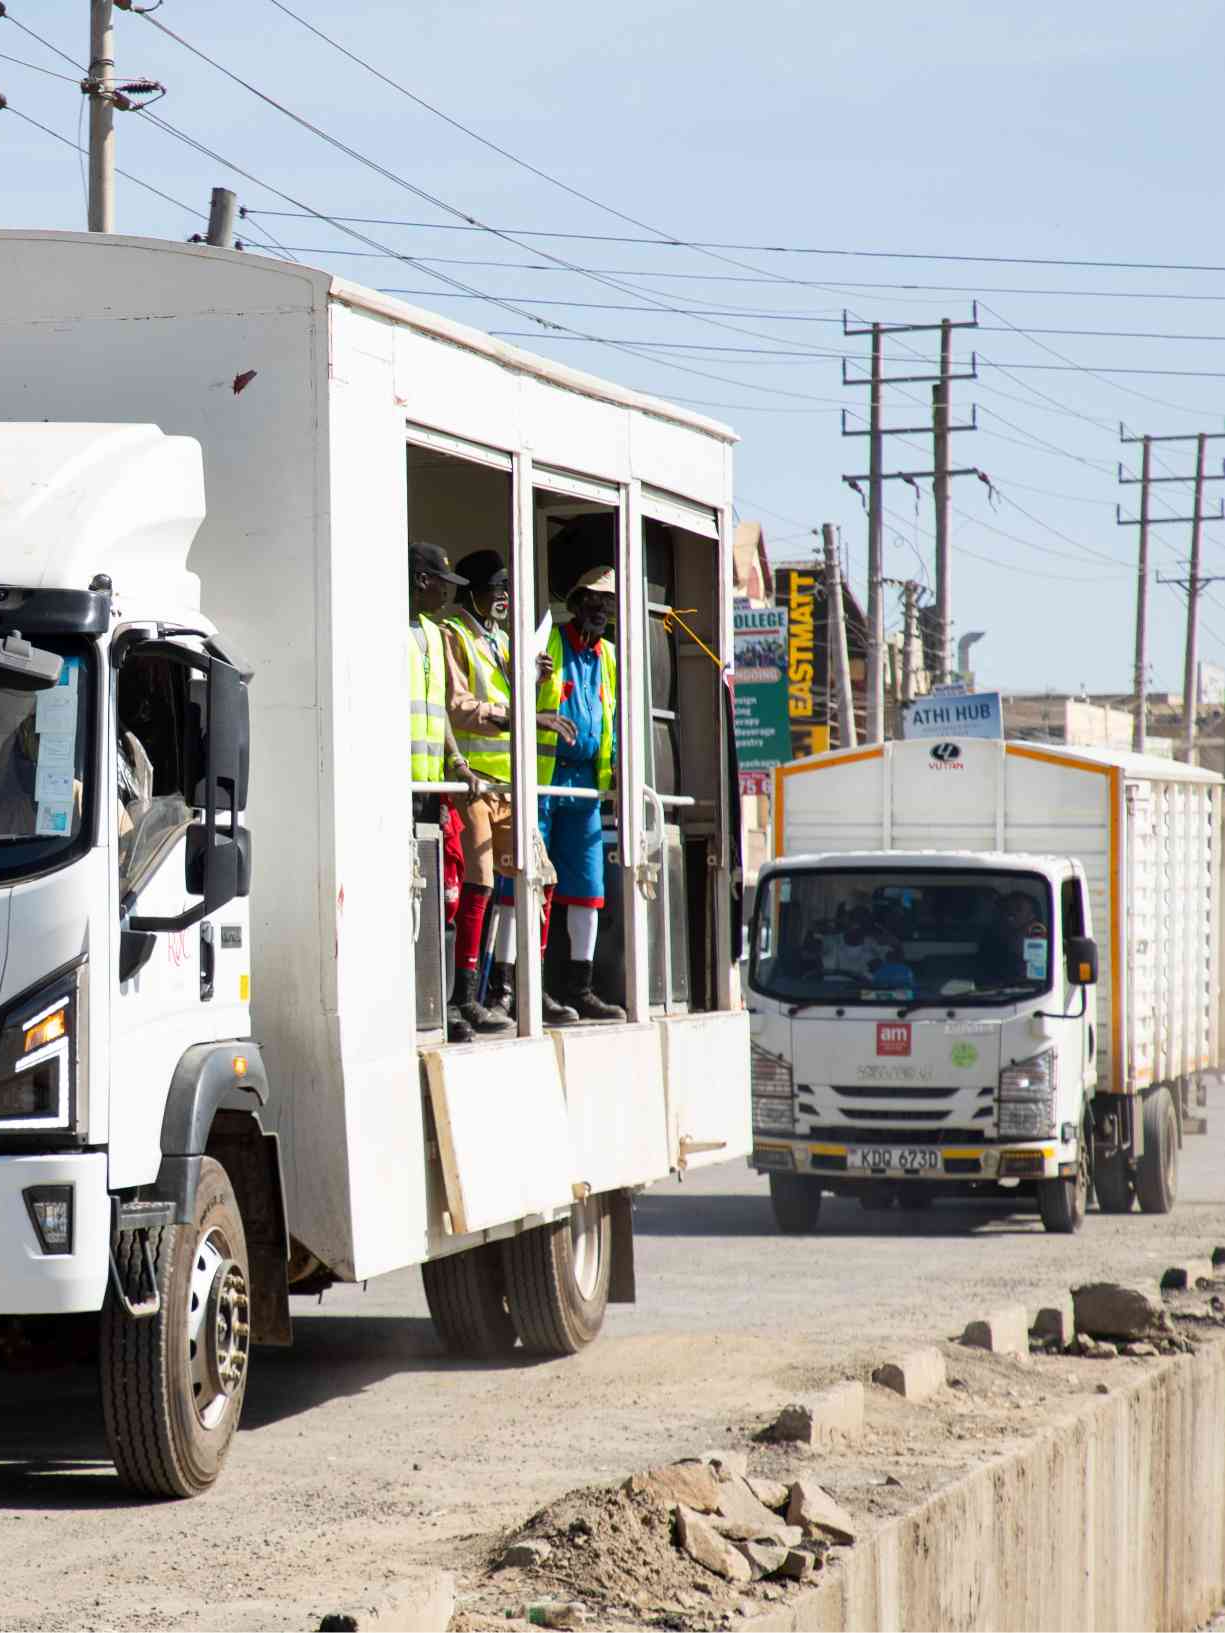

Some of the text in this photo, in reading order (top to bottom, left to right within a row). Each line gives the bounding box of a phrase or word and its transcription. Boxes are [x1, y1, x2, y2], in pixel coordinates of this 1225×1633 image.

[733, 611, 786, 629] OLLEGE
[789, 570, 815, 717] EASTMATT
[913, 703, 993, 726] ATHI HUB
[862, 1150, 938, 1169] KDQ 673D
